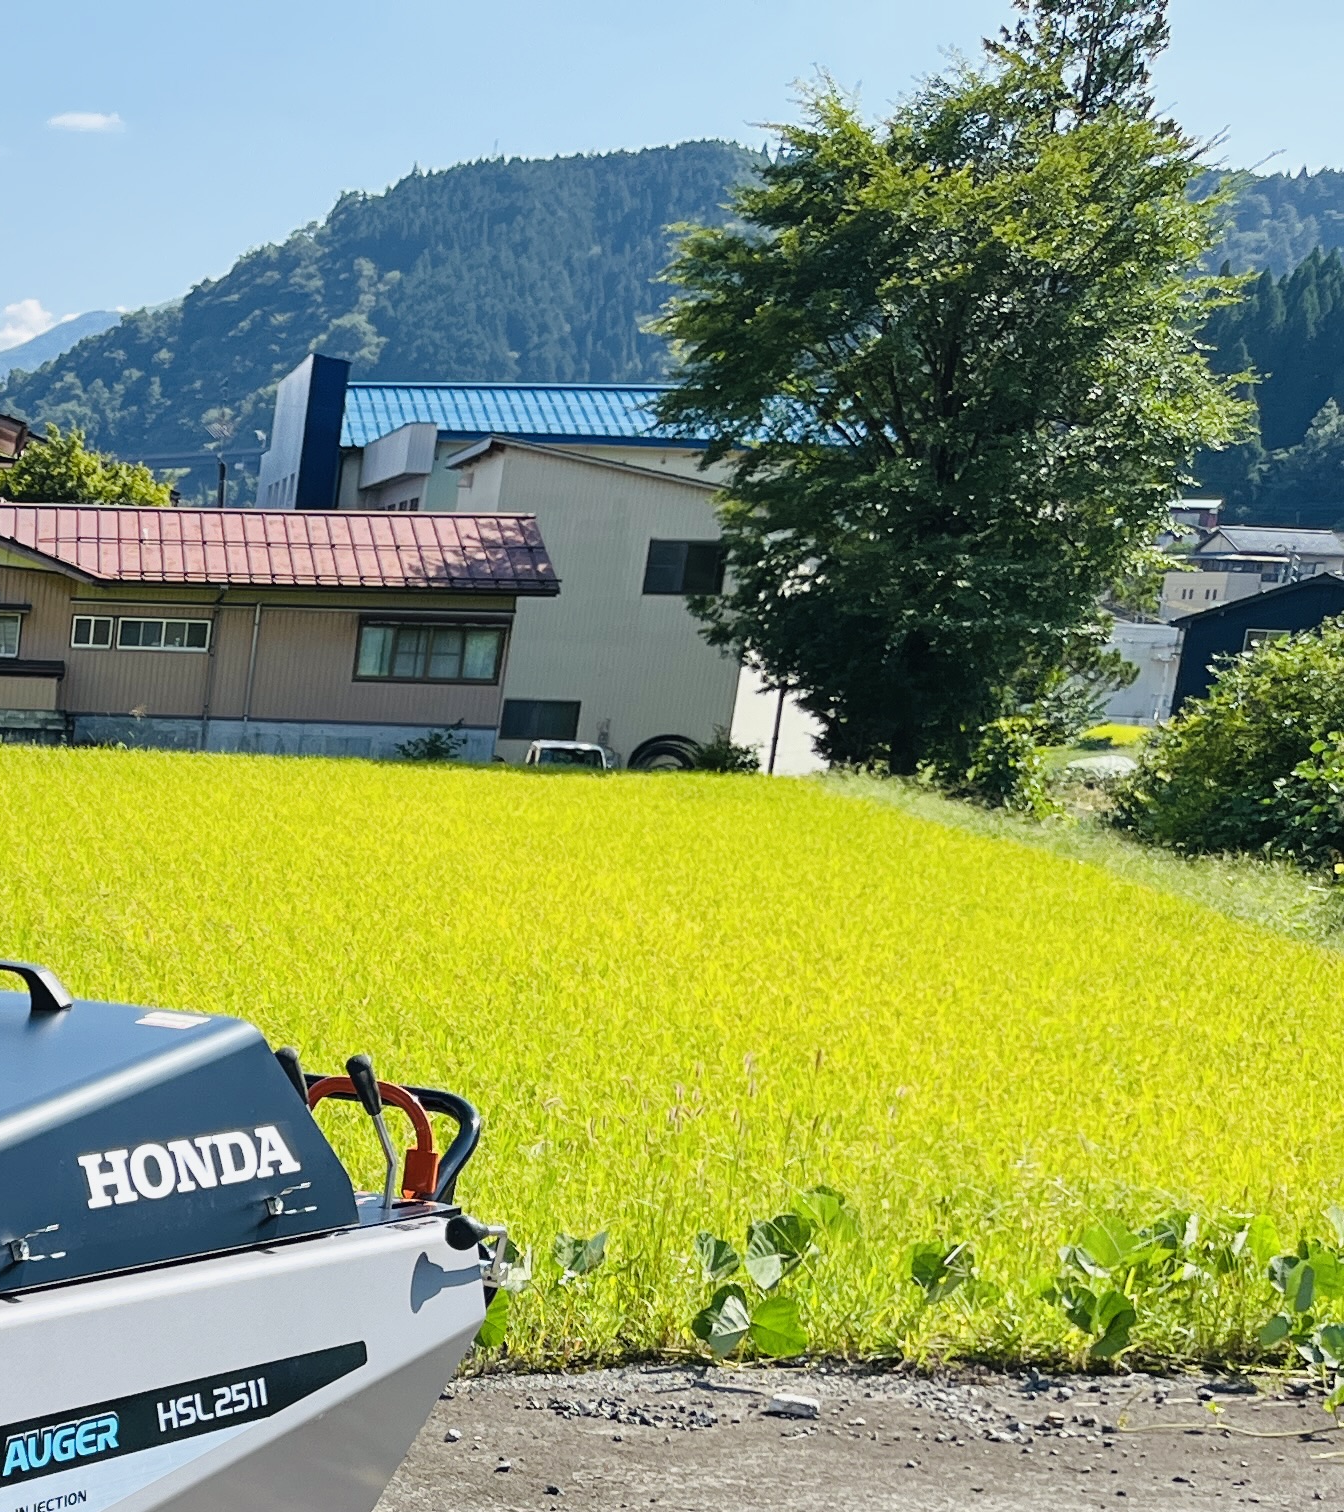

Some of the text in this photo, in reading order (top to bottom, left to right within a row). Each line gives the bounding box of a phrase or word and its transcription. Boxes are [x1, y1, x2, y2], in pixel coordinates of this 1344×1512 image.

[78, 1125, 302, 1210] HONDA
[156, 1377, 269, 1432] HSL2511
[2, 1411, 120, 1477] AUGER
